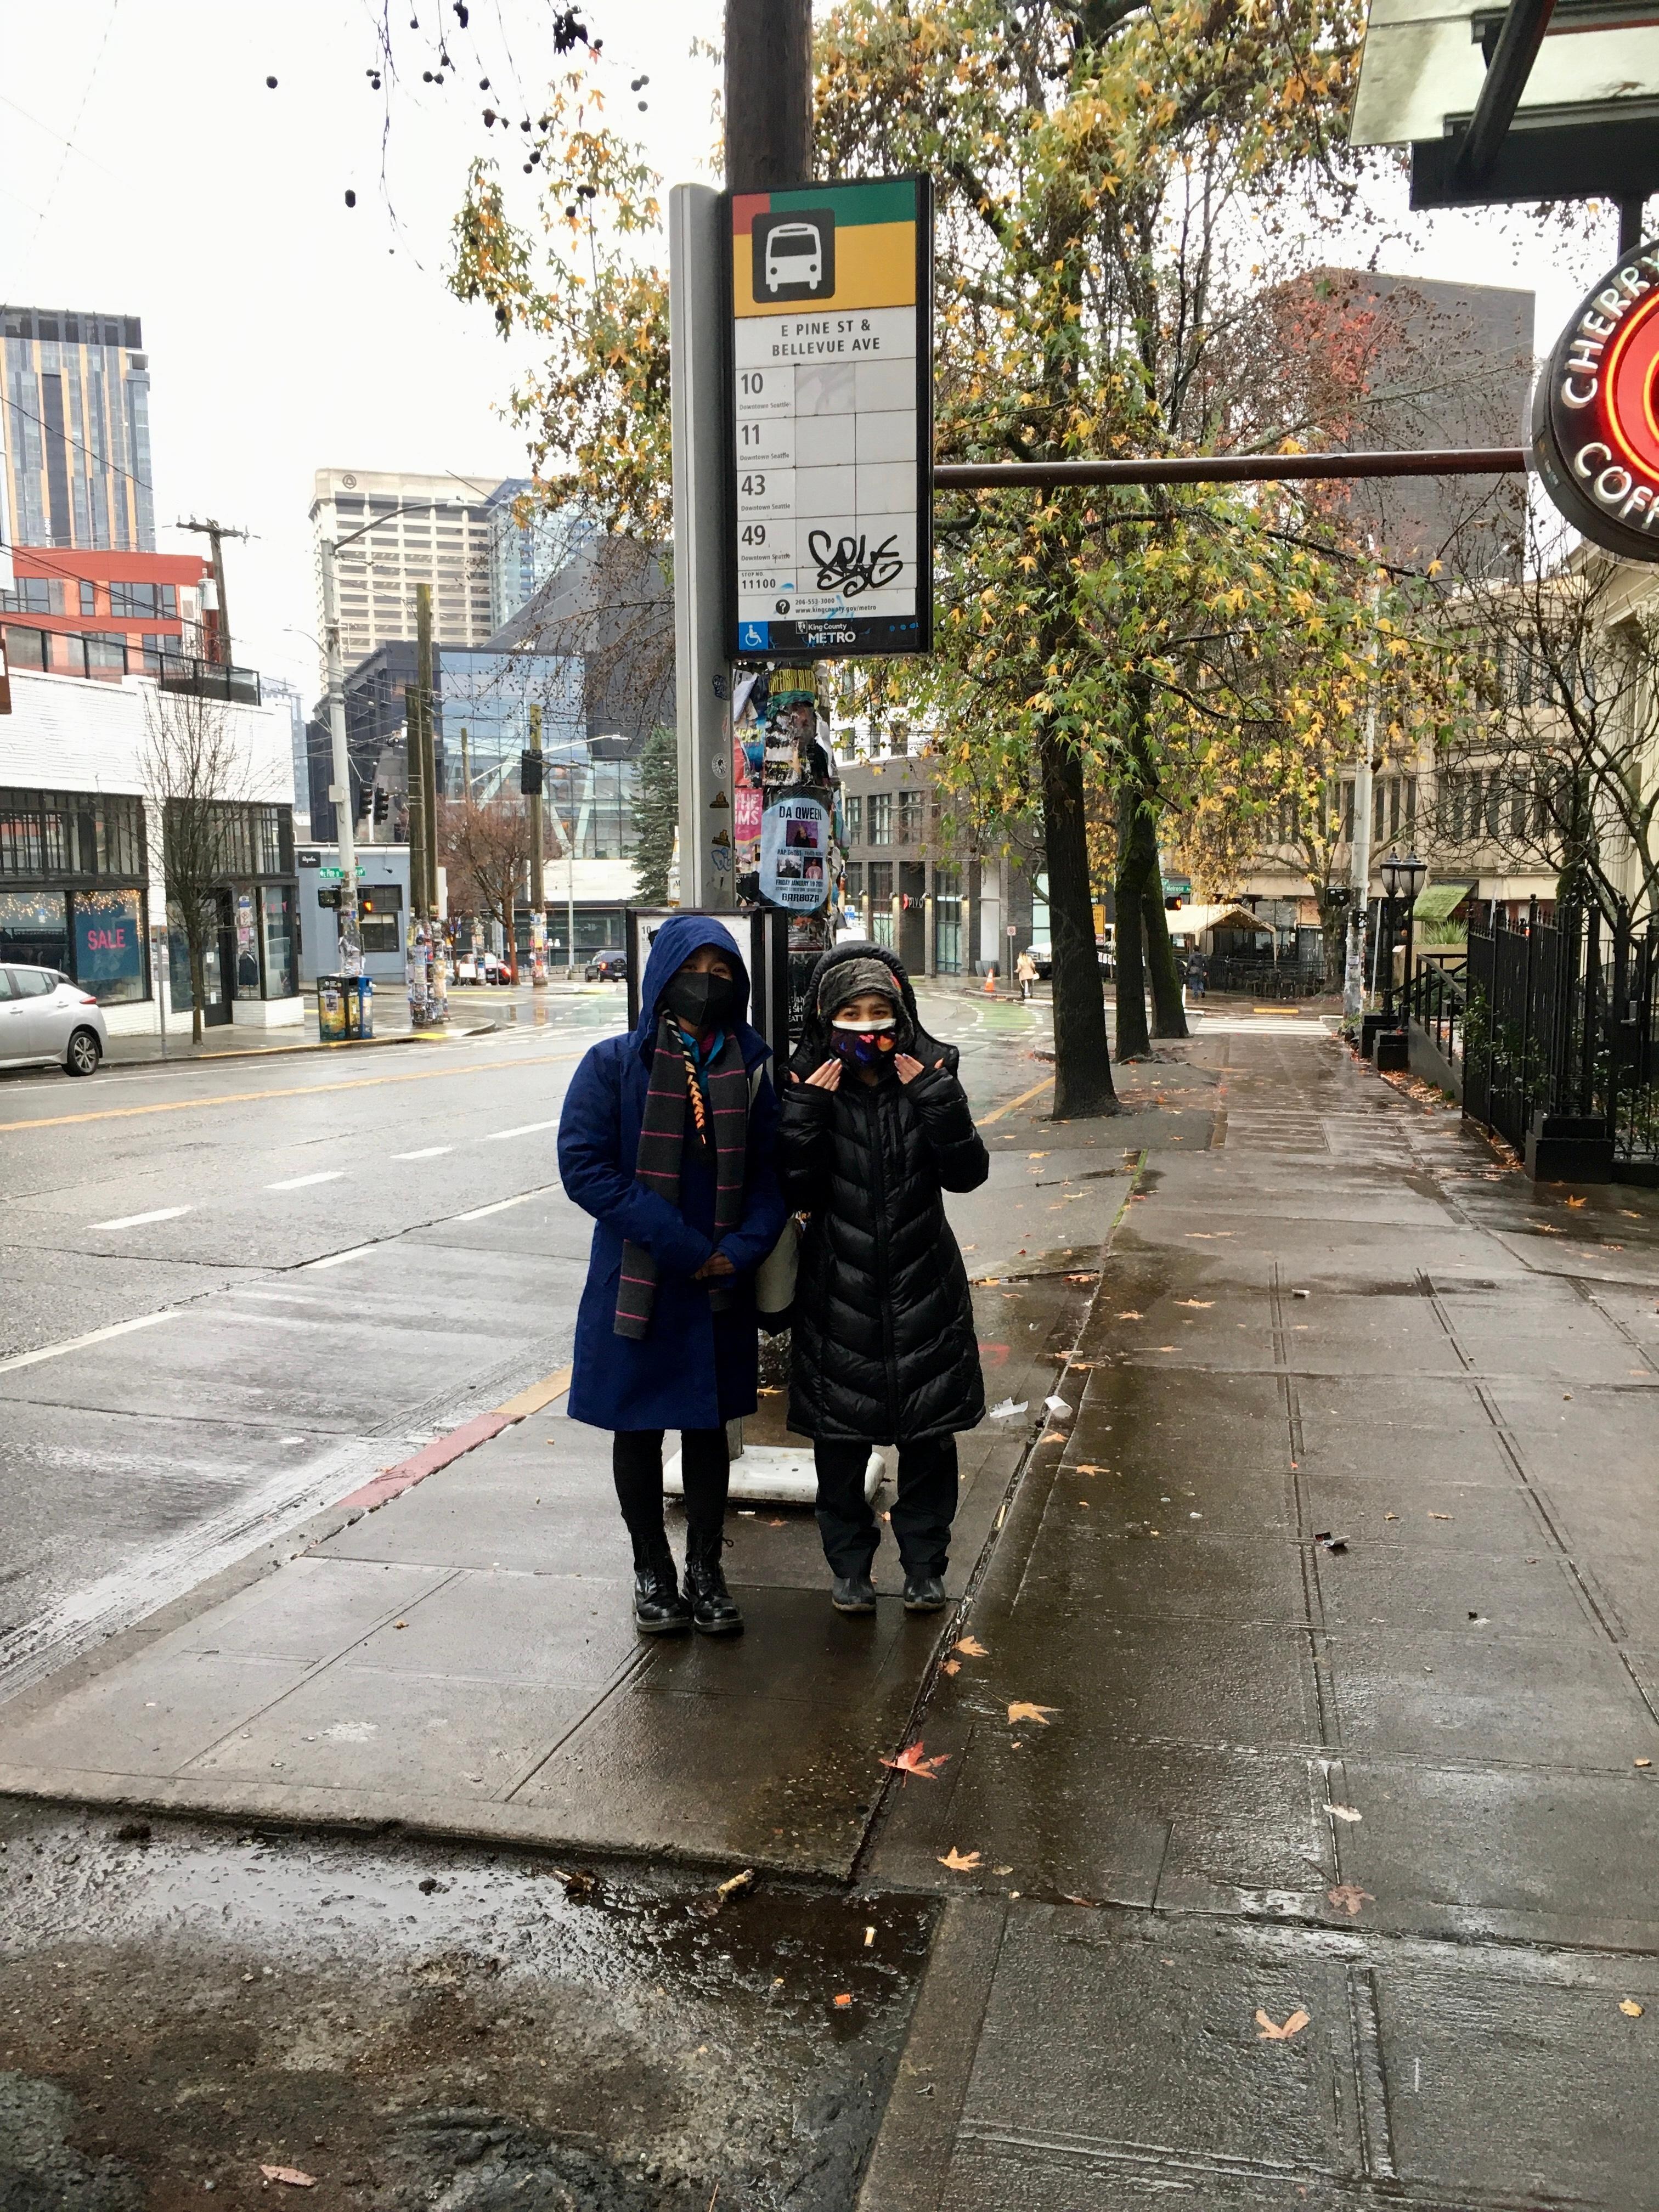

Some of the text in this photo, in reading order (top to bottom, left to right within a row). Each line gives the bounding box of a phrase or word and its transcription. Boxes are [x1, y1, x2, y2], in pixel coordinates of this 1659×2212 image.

[781, 319, 871, 337] E PINE ST &
[772, 337, 881, 357] BELLEVUE AVE
[741, 373, 764, 394] 10
[741, 424, 760, 445] 11
[771, 452, 790, 460] Seattle
[741, 474, 766, 496] 43
[741, 524, 766, 546] 49
[742, 578, 776, 589] 11100
[795, 605, 877, 614] www.kingcounty.gov/metro
[808, 631, 856, 644] METRO
[779, 806, 822, 821] DA QWEEN
[782, 893, 820, 903] BARBOZA
[641, 926, 651, 934] 10
[88, 928, 126, 951] SALE
